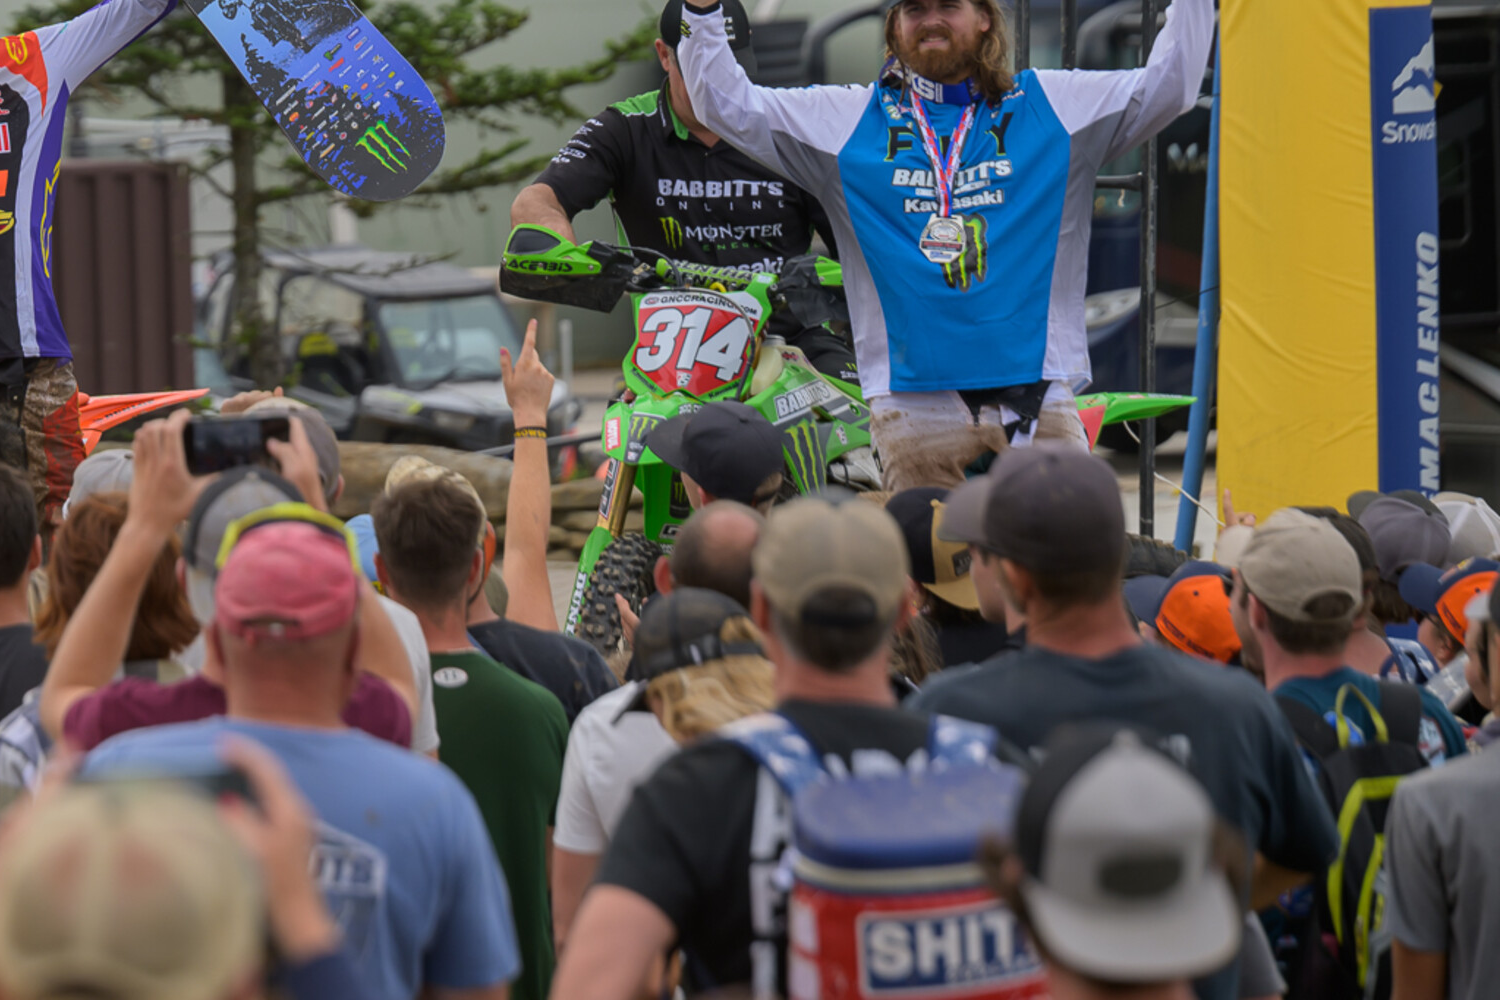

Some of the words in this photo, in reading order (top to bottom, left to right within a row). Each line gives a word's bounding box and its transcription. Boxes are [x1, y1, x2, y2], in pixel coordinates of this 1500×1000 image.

[1381, 119, 1436, 144] Snows
[891, 159, 1013, 187] BAITT'S
[657, 178, 784, 198] BABBITT'S
[685, 222, 783, 243] MONSTER
[660, 293, 758, 316] GNCCRACINGOM
[635, 306, 755, 383] 314
[1414, 231, 1440, 498] MACLENKO
[869, 907, 1015, 980] SHIT
